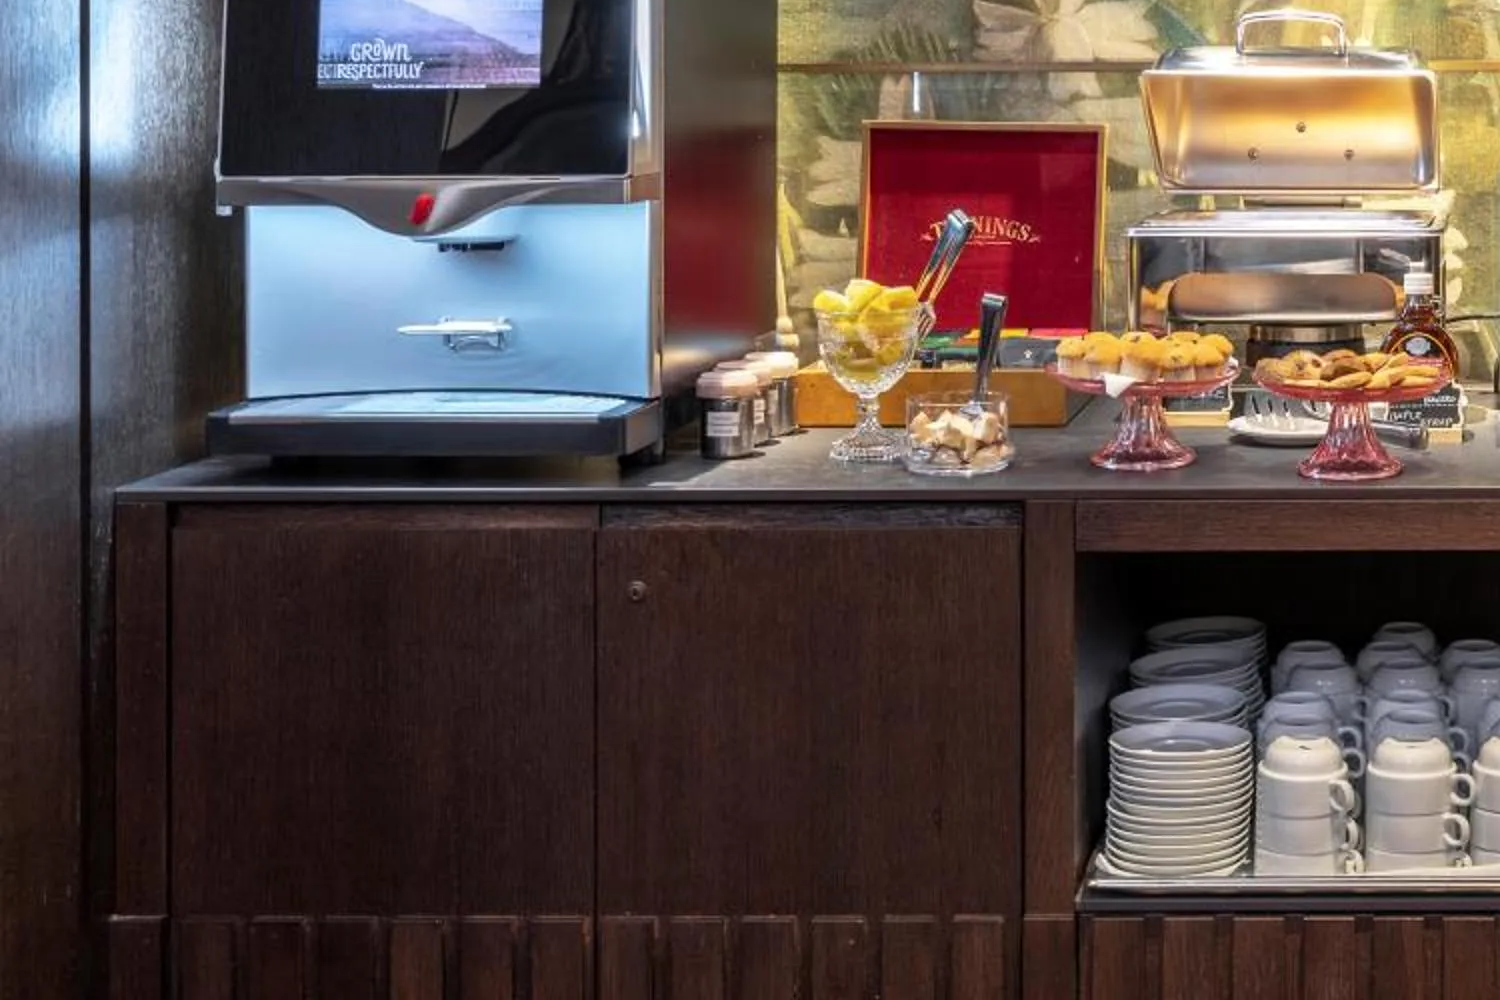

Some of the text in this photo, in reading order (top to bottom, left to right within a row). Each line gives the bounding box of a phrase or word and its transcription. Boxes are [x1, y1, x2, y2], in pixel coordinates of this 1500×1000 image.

[352, 38, 412, 61] GROWN
[337, 61, 424, 80] RESPECTFULLY
[929, 215, 1031, 241] TNINGS
